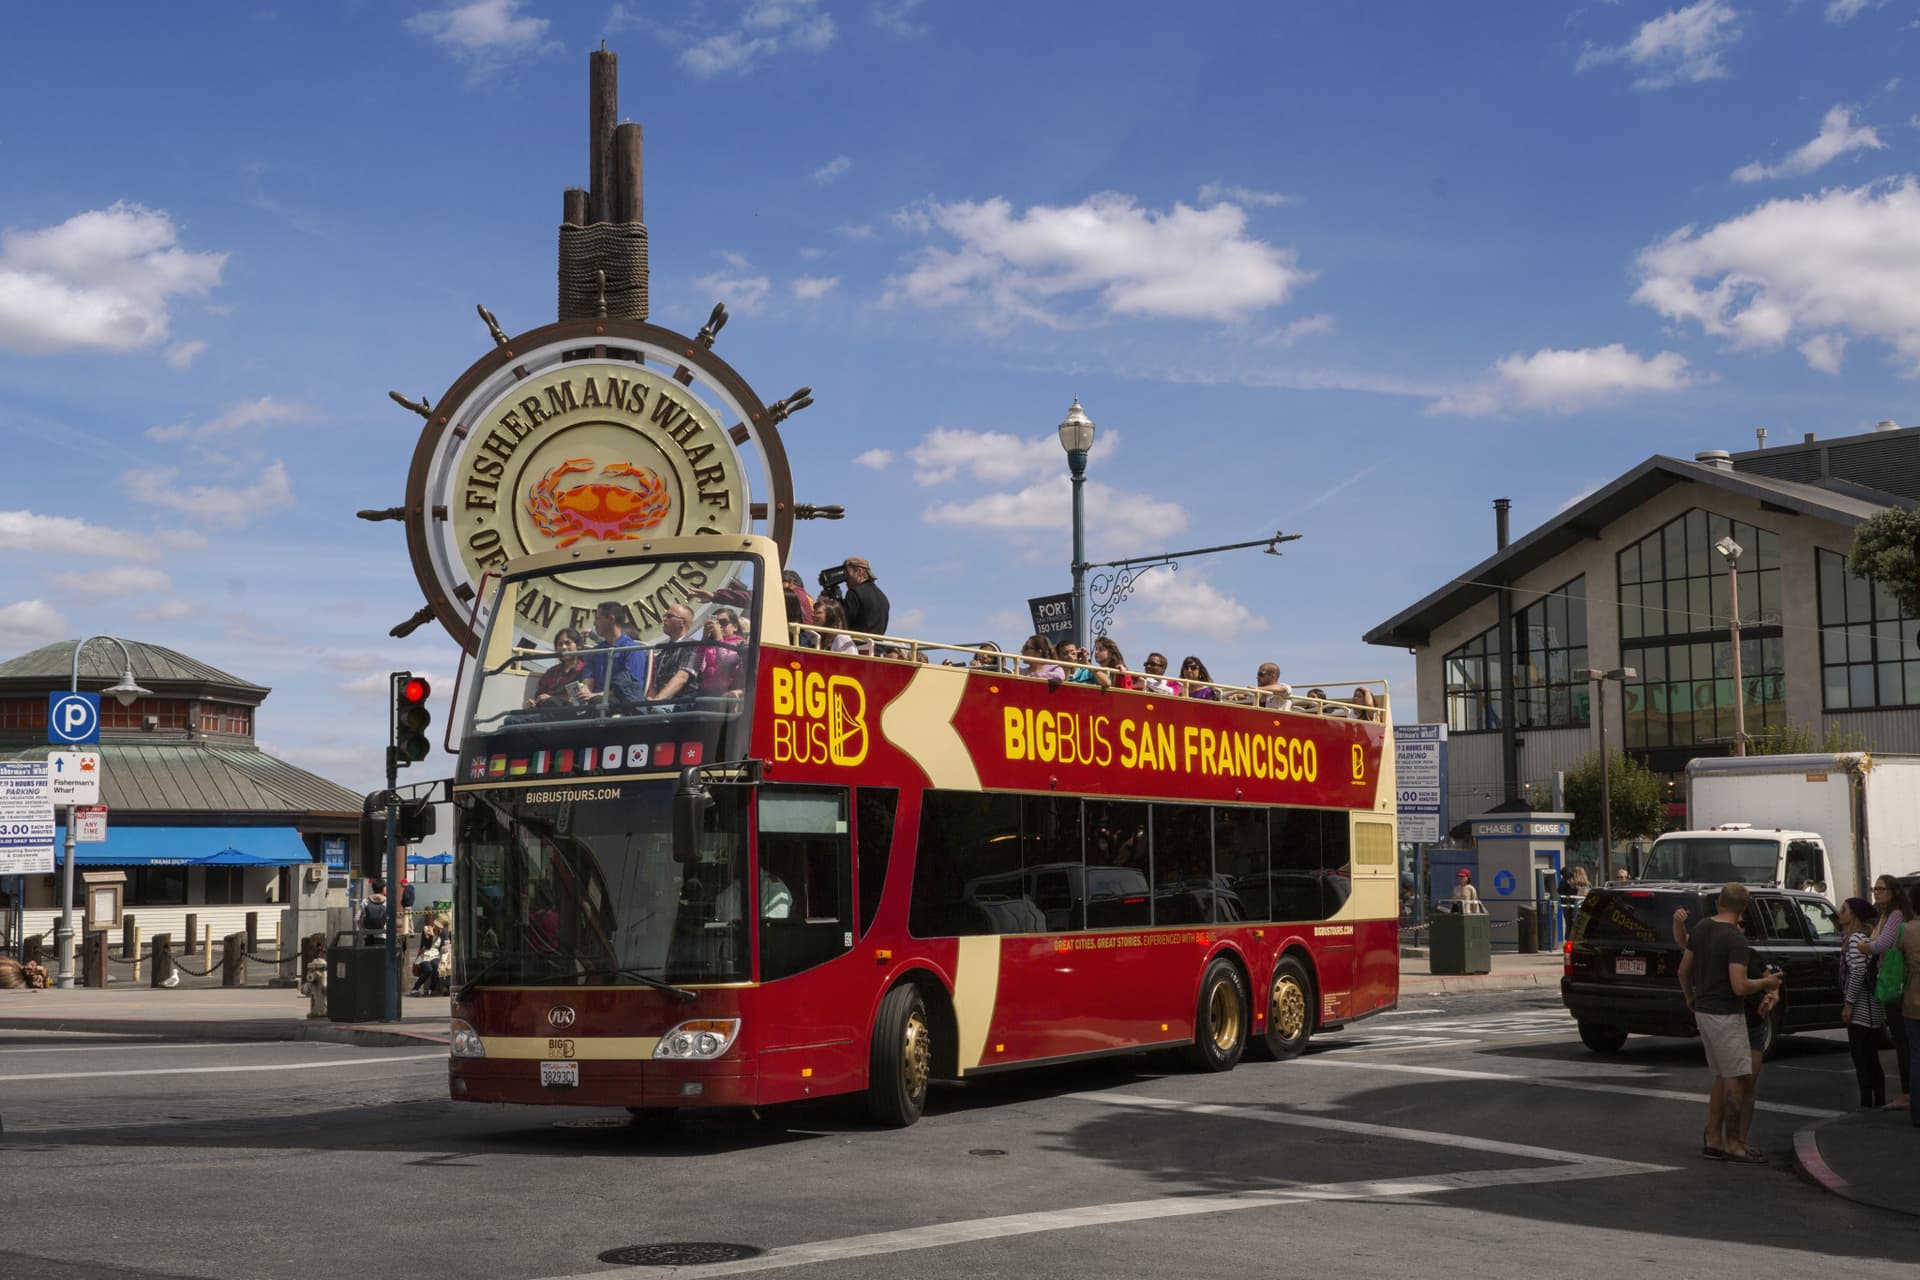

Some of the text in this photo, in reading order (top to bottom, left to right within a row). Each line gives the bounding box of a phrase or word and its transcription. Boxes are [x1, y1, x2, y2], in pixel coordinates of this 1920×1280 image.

[465, 377, 731, 512] FISHERMANS WHARF
[469, 529, 509, 569] OF
[515, 581, 562, 629] AN
[1039, 601, 1066, 618] PORT
[1037, 620, 1073, 633] 150 YEARS
[773, 667, 826, 719] BIG
[774, 719, 828, 765] BUS
[1003, 706, 1319, 783] BIGBUS SAN FRANCISCO
[526, 788, 621, 803] BIGBUSTOURS.COM
[1480, 824, 1513, 833] CHASE
[1534, 824, 1558, 833] CHASE
[1055, 938, 1074, 950] GREAT
[1097, 936, 1117, 949] GREAT
[1143, 933, 1181, 946] EXPERIENCED
[549, 1039, 563, 1049] BIG
